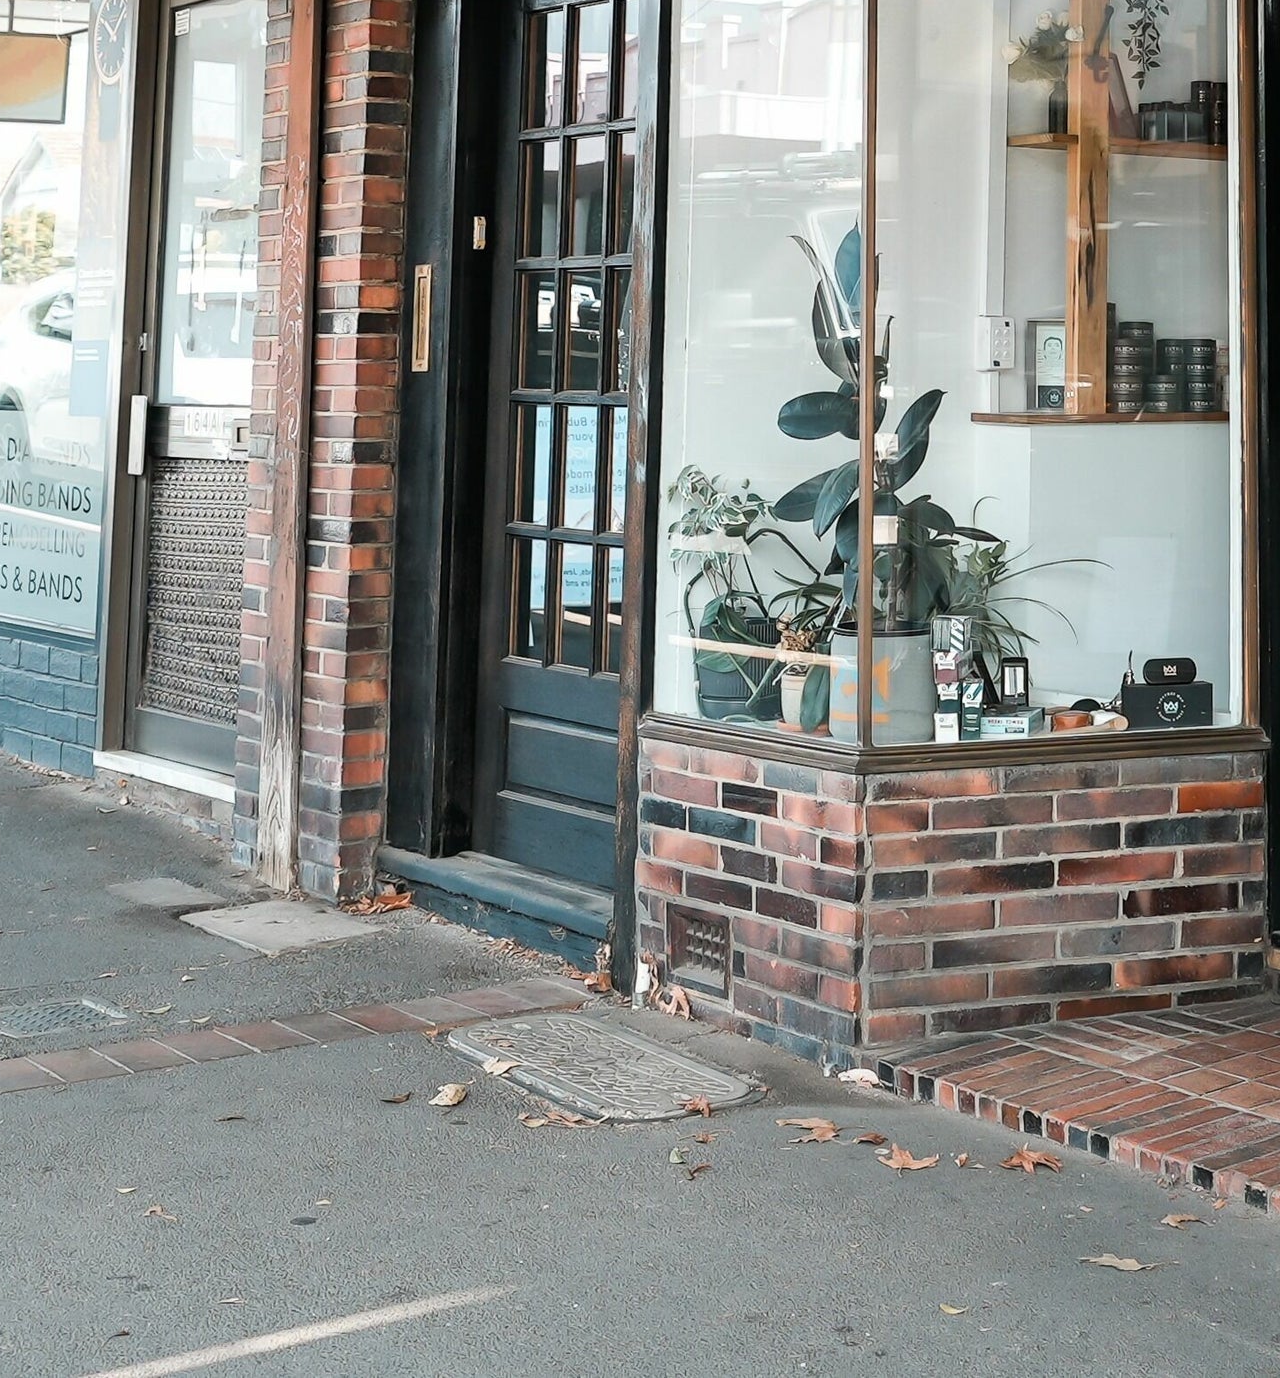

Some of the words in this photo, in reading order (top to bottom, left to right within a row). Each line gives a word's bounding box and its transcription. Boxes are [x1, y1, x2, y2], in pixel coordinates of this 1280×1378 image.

[37, 483, 92, 514] BANDS
[12, 565, 23, 592] &
[27, 569, 84, 604] BANDS
